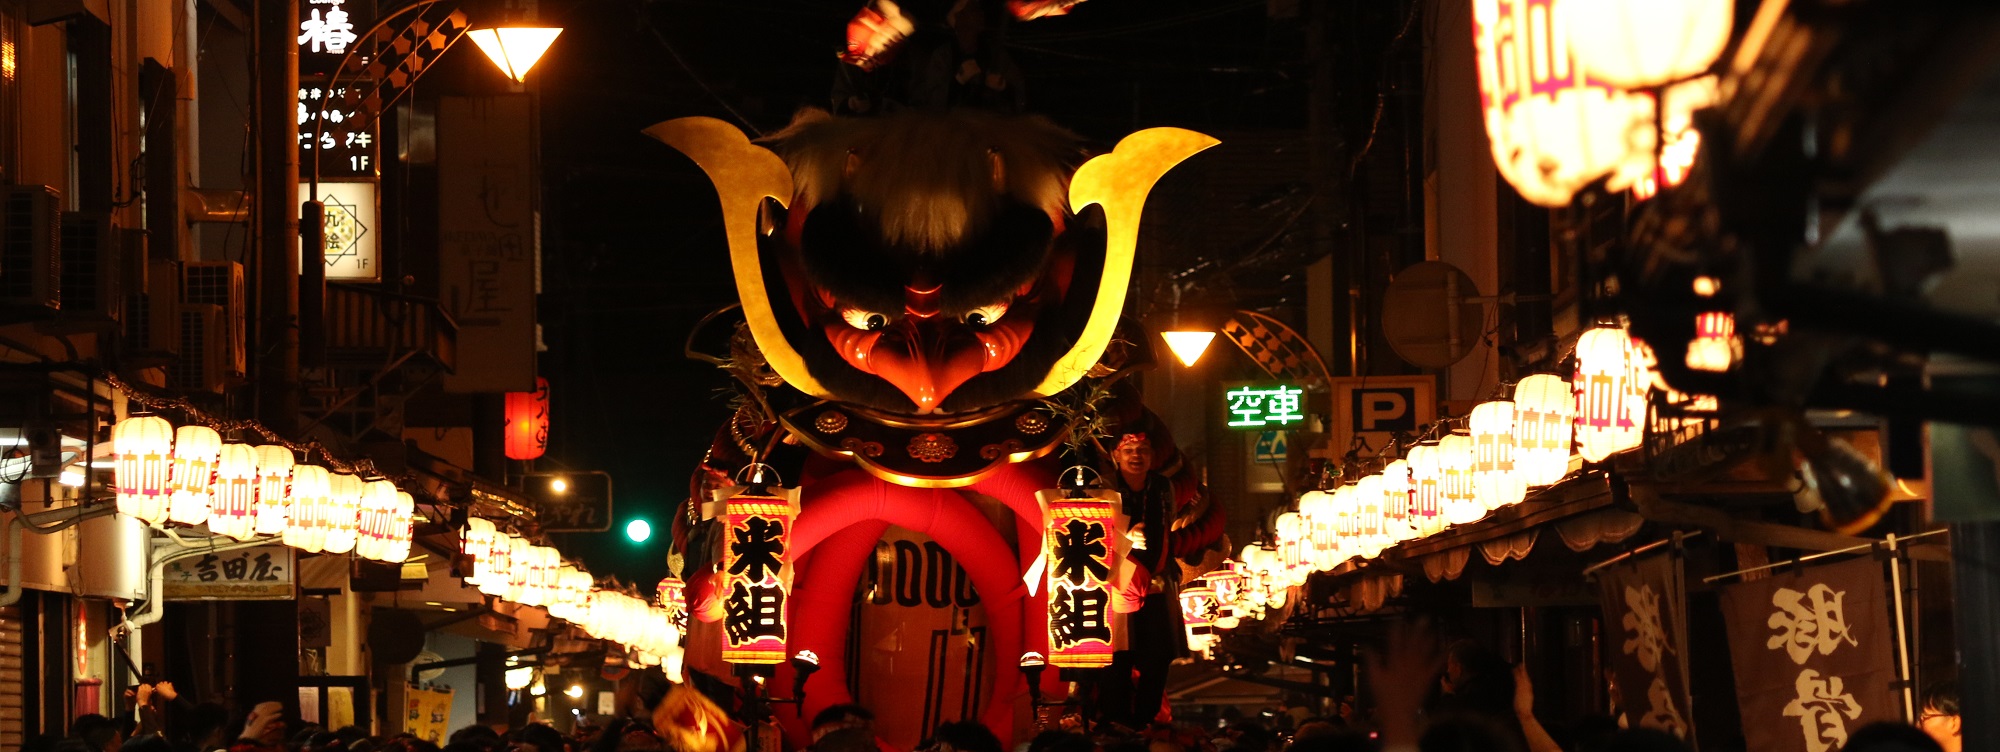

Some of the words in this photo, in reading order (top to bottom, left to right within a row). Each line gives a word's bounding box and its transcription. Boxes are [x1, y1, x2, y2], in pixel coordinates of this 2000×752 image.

[297, 5, 358, 53] 椿
[350, 155, 369, 171] 1F
[324, 210, 340, 250] 九絵
[356, 258, 369, 269] 1F
[1226, 384, 1304, 428] 空車
[1362, 392, 1407, 430] P
